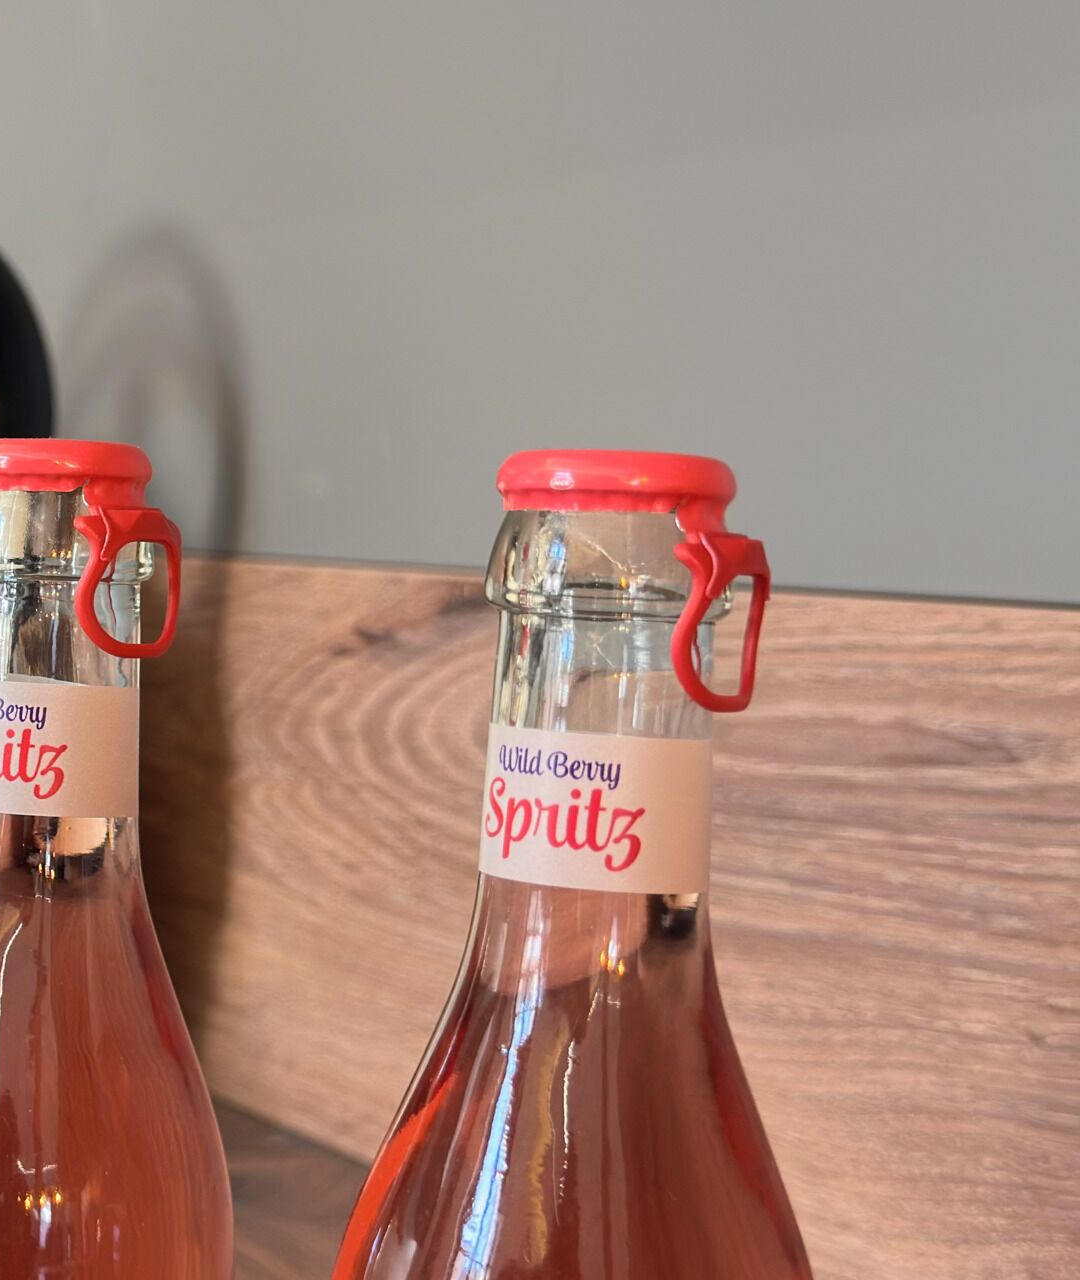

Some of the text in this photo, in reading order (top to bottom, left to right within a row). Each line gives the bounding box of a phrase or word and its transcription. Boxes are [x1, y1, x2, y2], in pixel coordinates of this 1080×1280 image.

[499, 744, 621, 790] Wild Berry
[485, 777, 646, 872] Spritz
